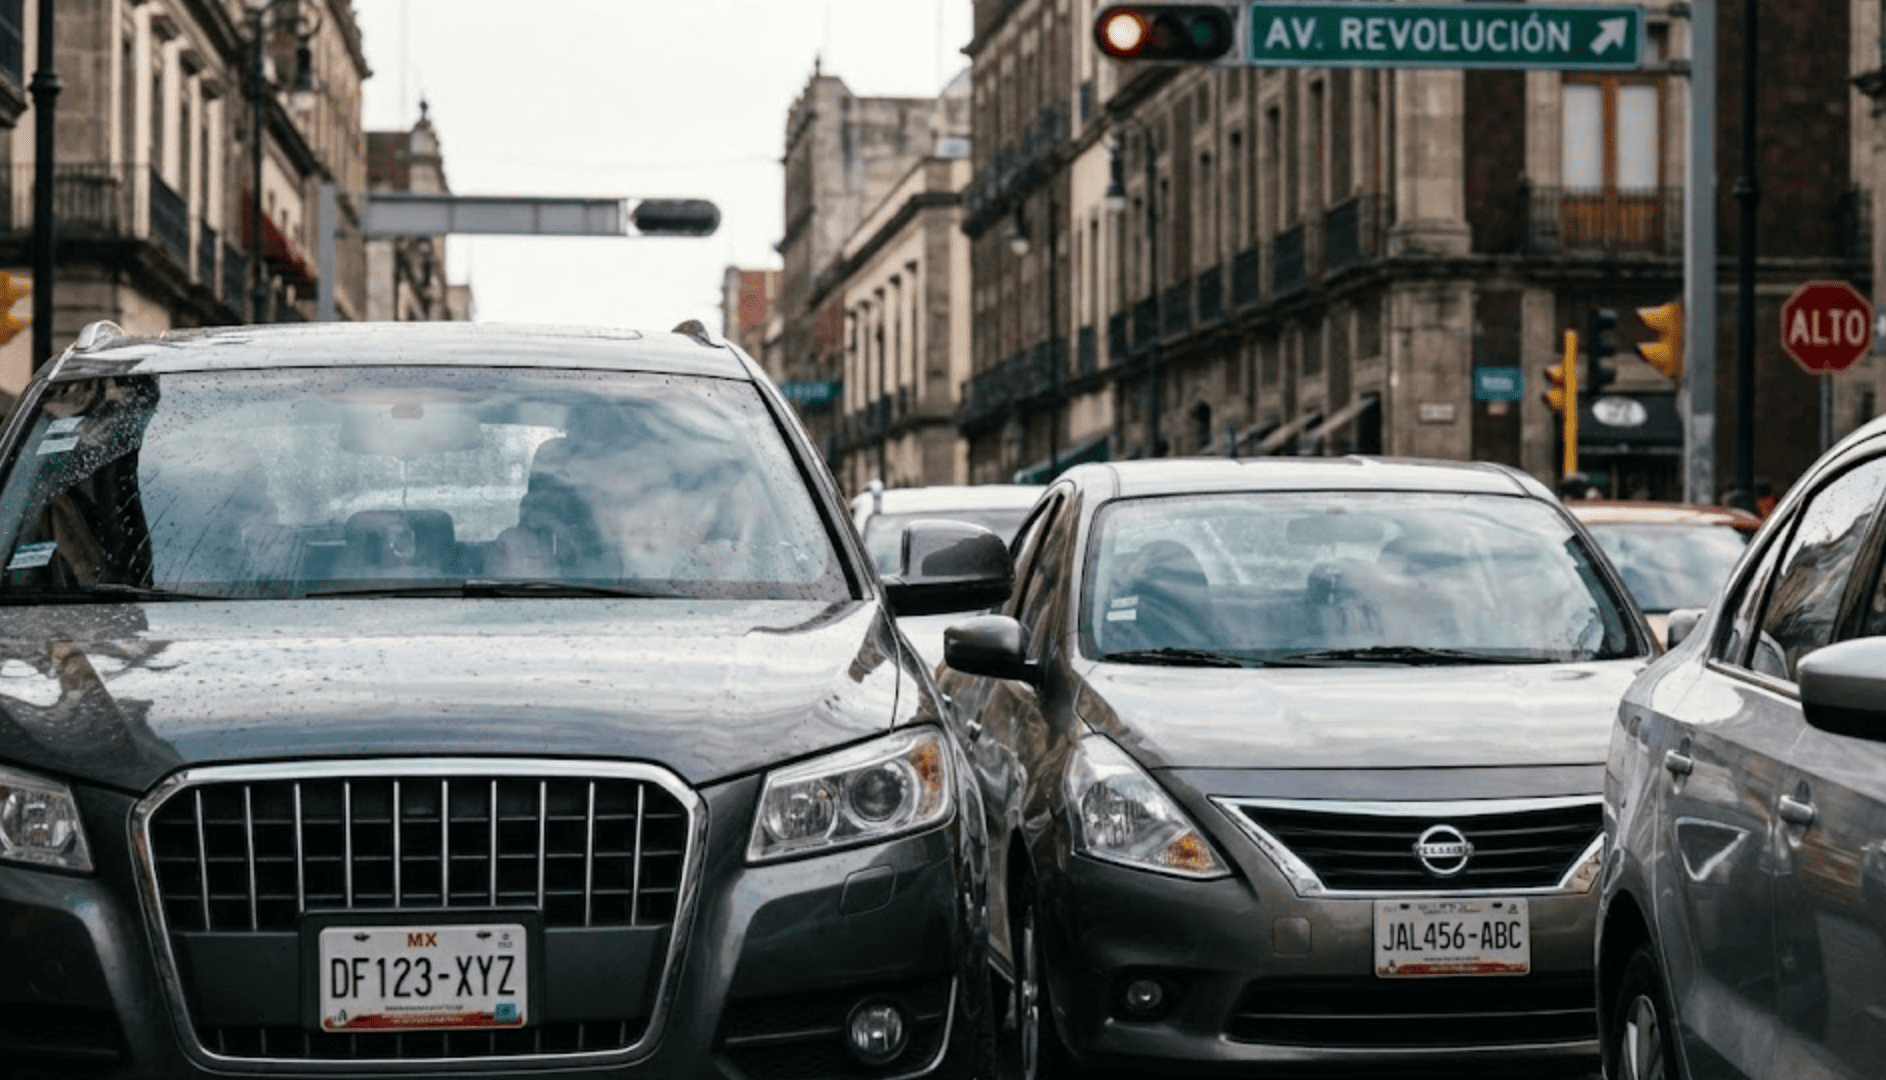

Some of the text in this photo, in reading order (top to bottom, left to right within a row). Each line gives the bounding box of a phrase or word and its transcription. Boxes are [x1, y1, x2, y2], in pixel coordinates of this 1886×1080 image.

[1264, 12, 1570, 52] AV. REVOLUCIÓN
[1789, 310, 1866, 344] ALTO
[407, 932, 438, 947] MX
[1383, 921, 1522, 951] JAL456-ABC
[331, 955, 515, 998] DF123-XYZ
